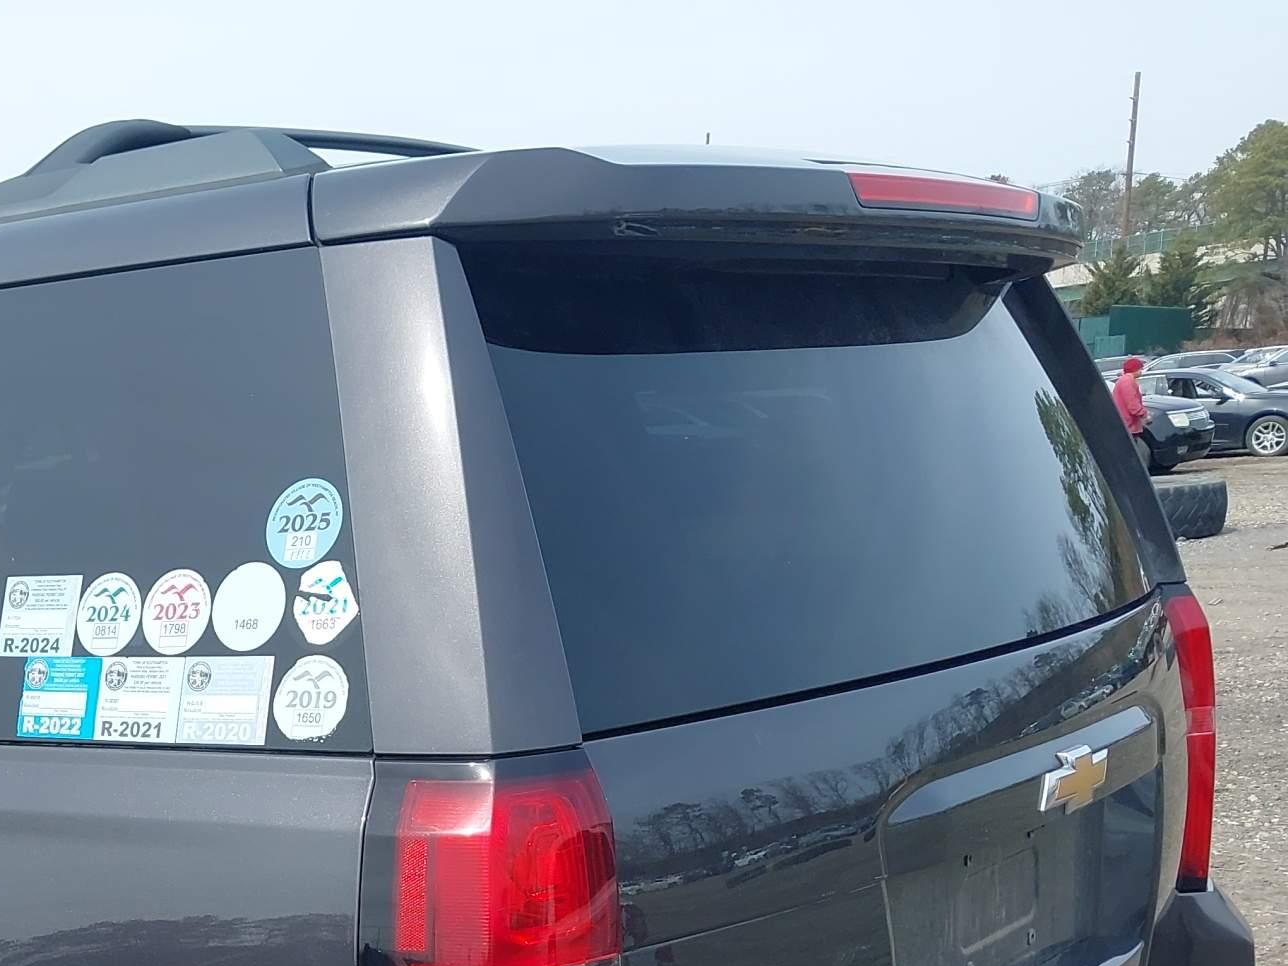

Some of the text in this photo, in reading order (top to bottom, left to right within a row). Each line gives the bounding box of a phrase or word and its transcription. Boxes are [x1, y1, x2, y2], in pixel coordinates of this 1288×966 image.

[278, 512, 332, 534] 2025
[290, 535, 312, 547] 210
[86, 604, 131, 623] 2024
[152, 602, 201, 621] 2023
[300, 597, 348, 616] 2021
[94, 625, 117, 637] 0814
[163, 622, 186, 635] 1798
[234, 618, 259, 630] 1468
[3, 637, 60, 654] R-2024
[285, 690, 337, 709] 2019
[22, 716, 81, 735] R-2022
[296, 712, 322, 724] 1650
[100, 720, 162, 739] R-2021
